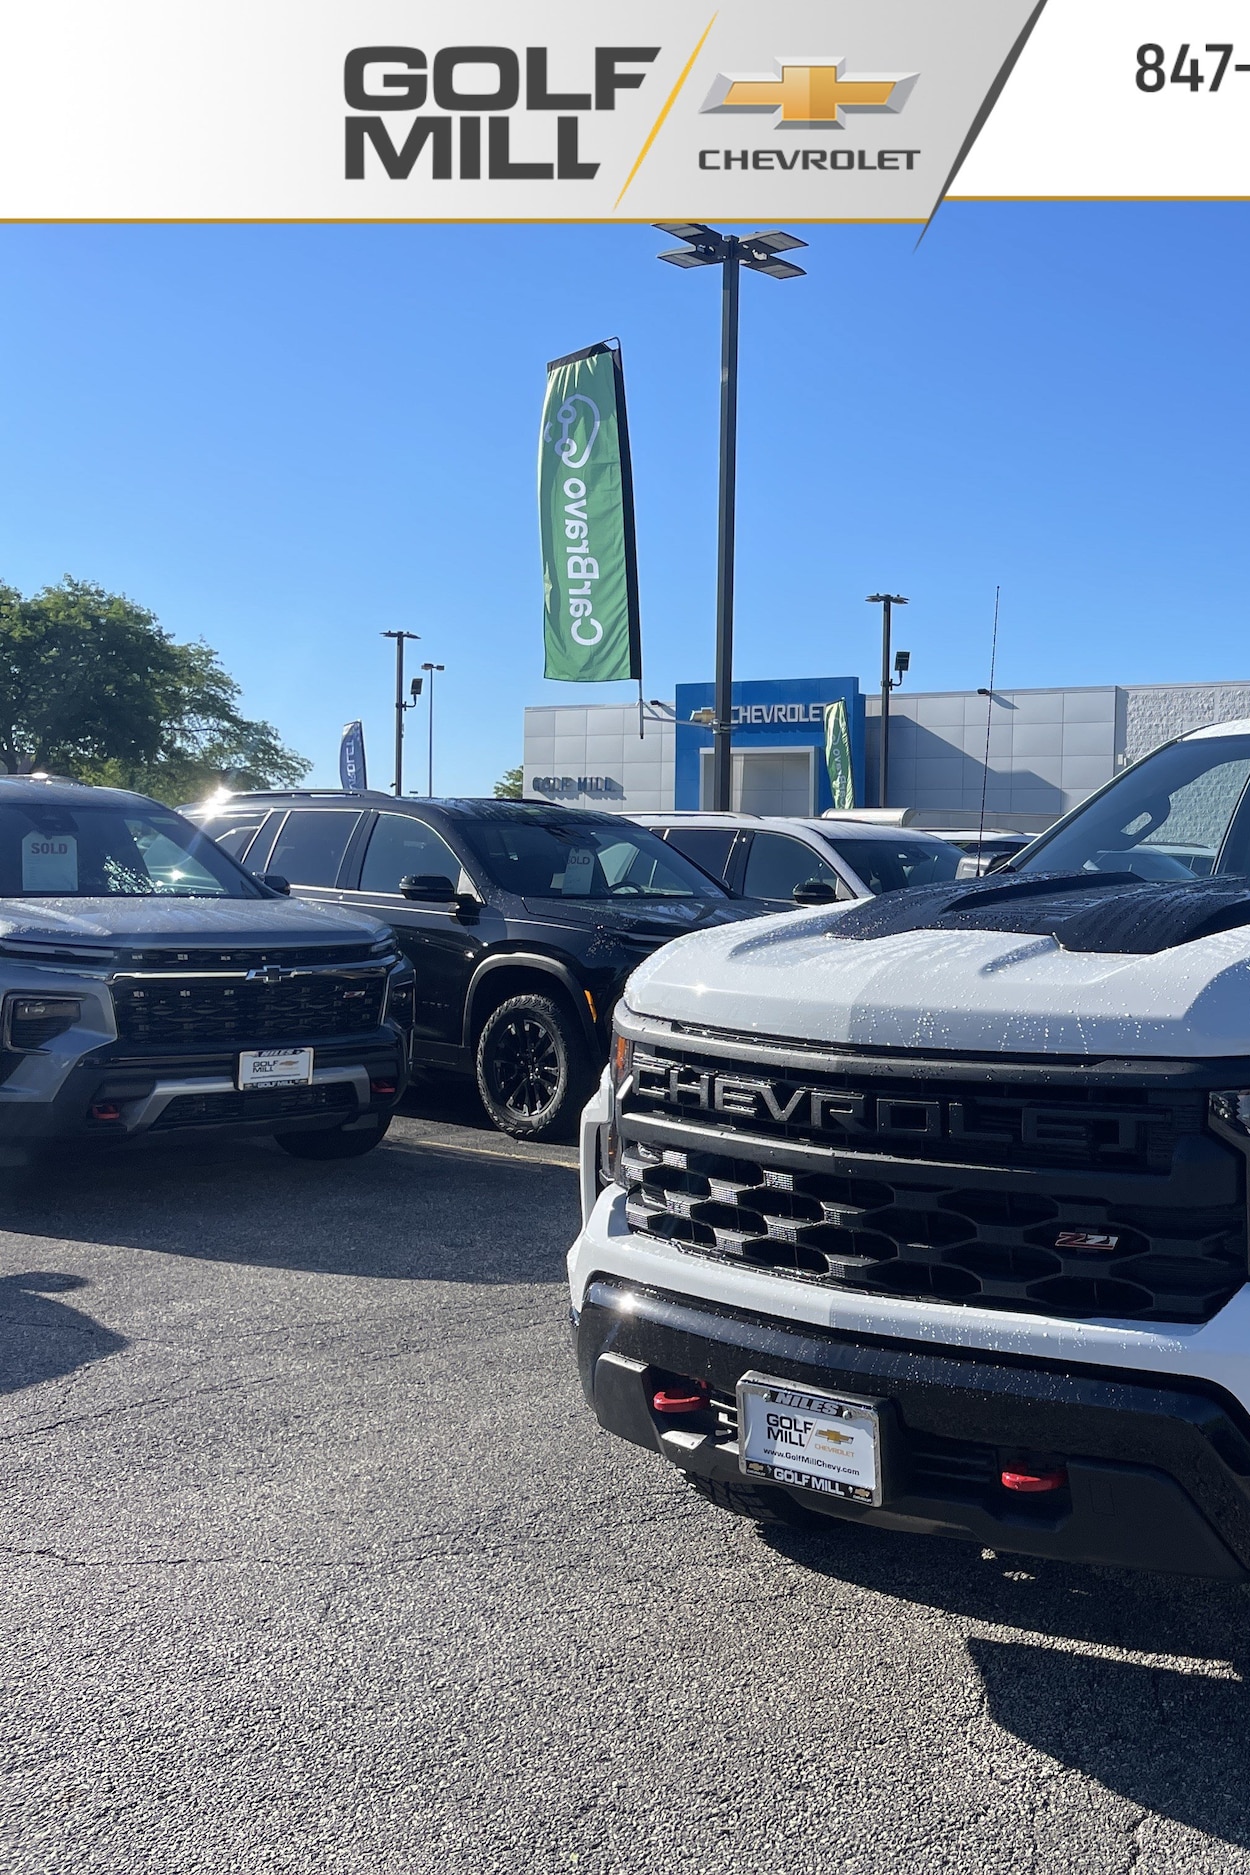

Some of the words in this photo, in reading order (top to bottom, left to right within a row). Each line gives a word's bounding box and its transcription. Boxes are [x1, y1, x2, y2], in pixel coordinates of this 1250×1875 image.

[31, 842, 68, 855] SOLD
[252, 1060, 279, 1068] GOLF
[632, 1056, 1171, 1152] CHEVROLET
[775, 1392, 839, 1415] NILES
[766, 1412, 814, 1434] GOLF
[767, 1427, 805, 1448] MILL
[763, 1447, 860, 1476] www.GolfMillChevy.com
[815, 1443, 855, 1458] CHEVROLET
[773, 1467, 810, 1486] GOLF
[811, 1478, 845, 1496] MILL
